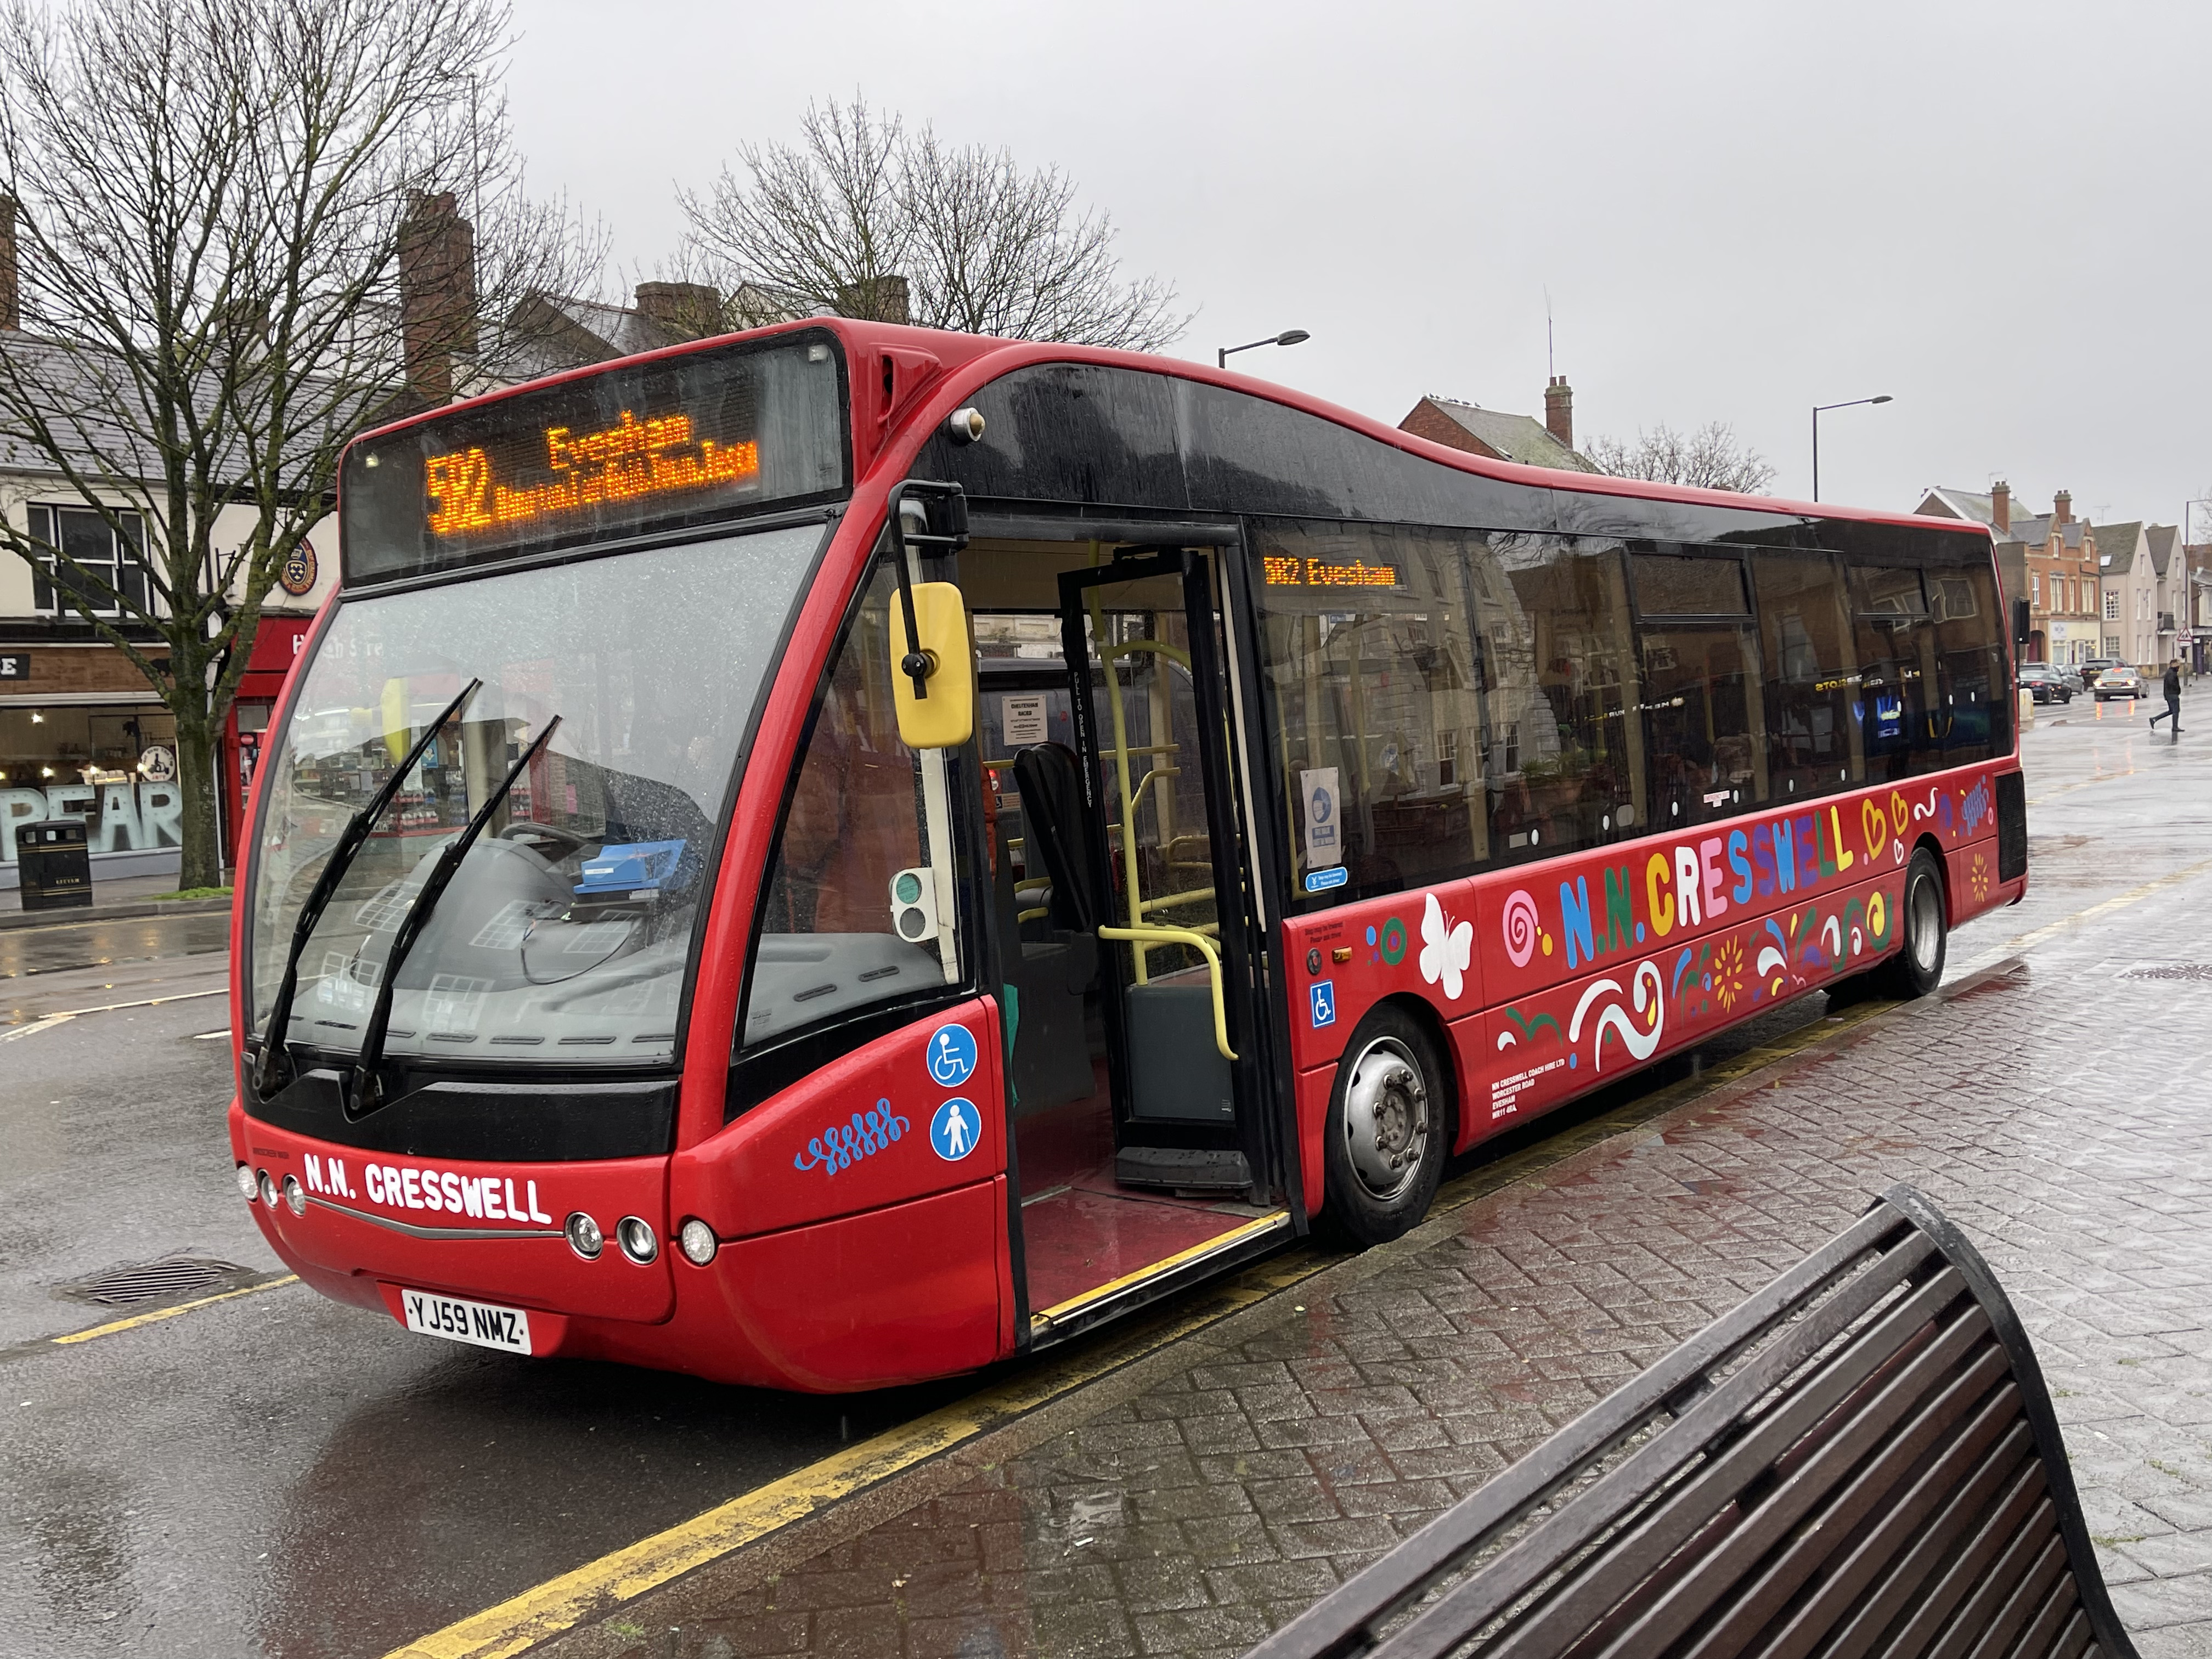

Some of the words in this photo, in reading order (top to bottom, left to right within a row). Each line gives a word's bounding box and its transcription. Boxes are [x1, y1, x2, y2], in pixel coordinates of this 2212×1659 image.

[1306, 559, 1395, 585] Evesham
[1077, 698, 1082, 710] TO
[1083, 755, 1092, 808] EMERGENCY
[1492, 1081, 1499, 1091] NN
[1500, 1071, 1528, 1087] CRESSWELL
[1528, 1065, 1544, 1077] COACH
[1545, 1062, 1556, 1071] HIRE
[1556, 1058, 1565, 1067] LTD
[1492, 1084, 1521, 1100] WORCESTER
[1522, 1079, 1535, 1089] ROAD
[1492, 1094, 1516, 1110] EVESHAM
[1492, 1108, 1505, 1119] WR11
[304, 1153, 357, 1200] N.N.
[365, 1163, 552, 1224] CRESSWELL
[411, 1296, 469, 1335] YJ59
[472, 1307, 520, 1345] NMZ
